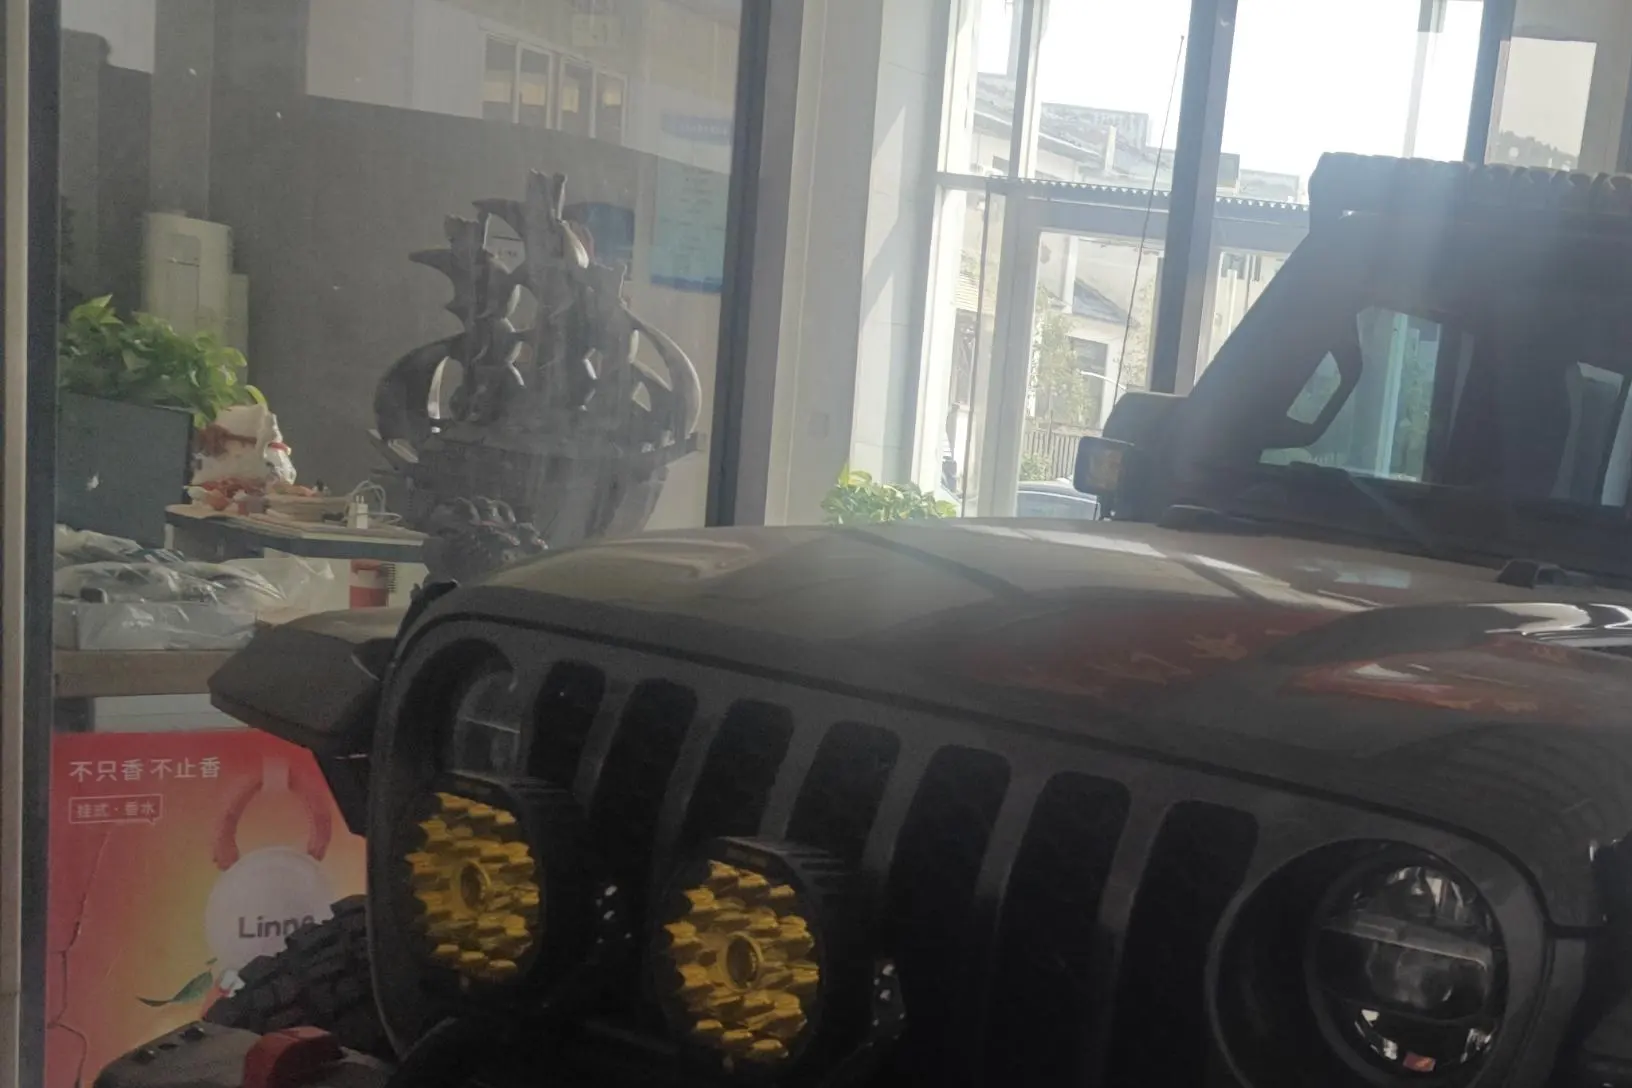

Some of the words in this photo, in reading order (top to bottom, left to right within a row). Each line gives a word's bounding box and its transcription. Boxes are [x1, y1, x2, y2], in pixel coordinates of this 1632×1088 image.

[68, 758, 144, 783] 不只香
[150, 755, 222, 780] 不止香
